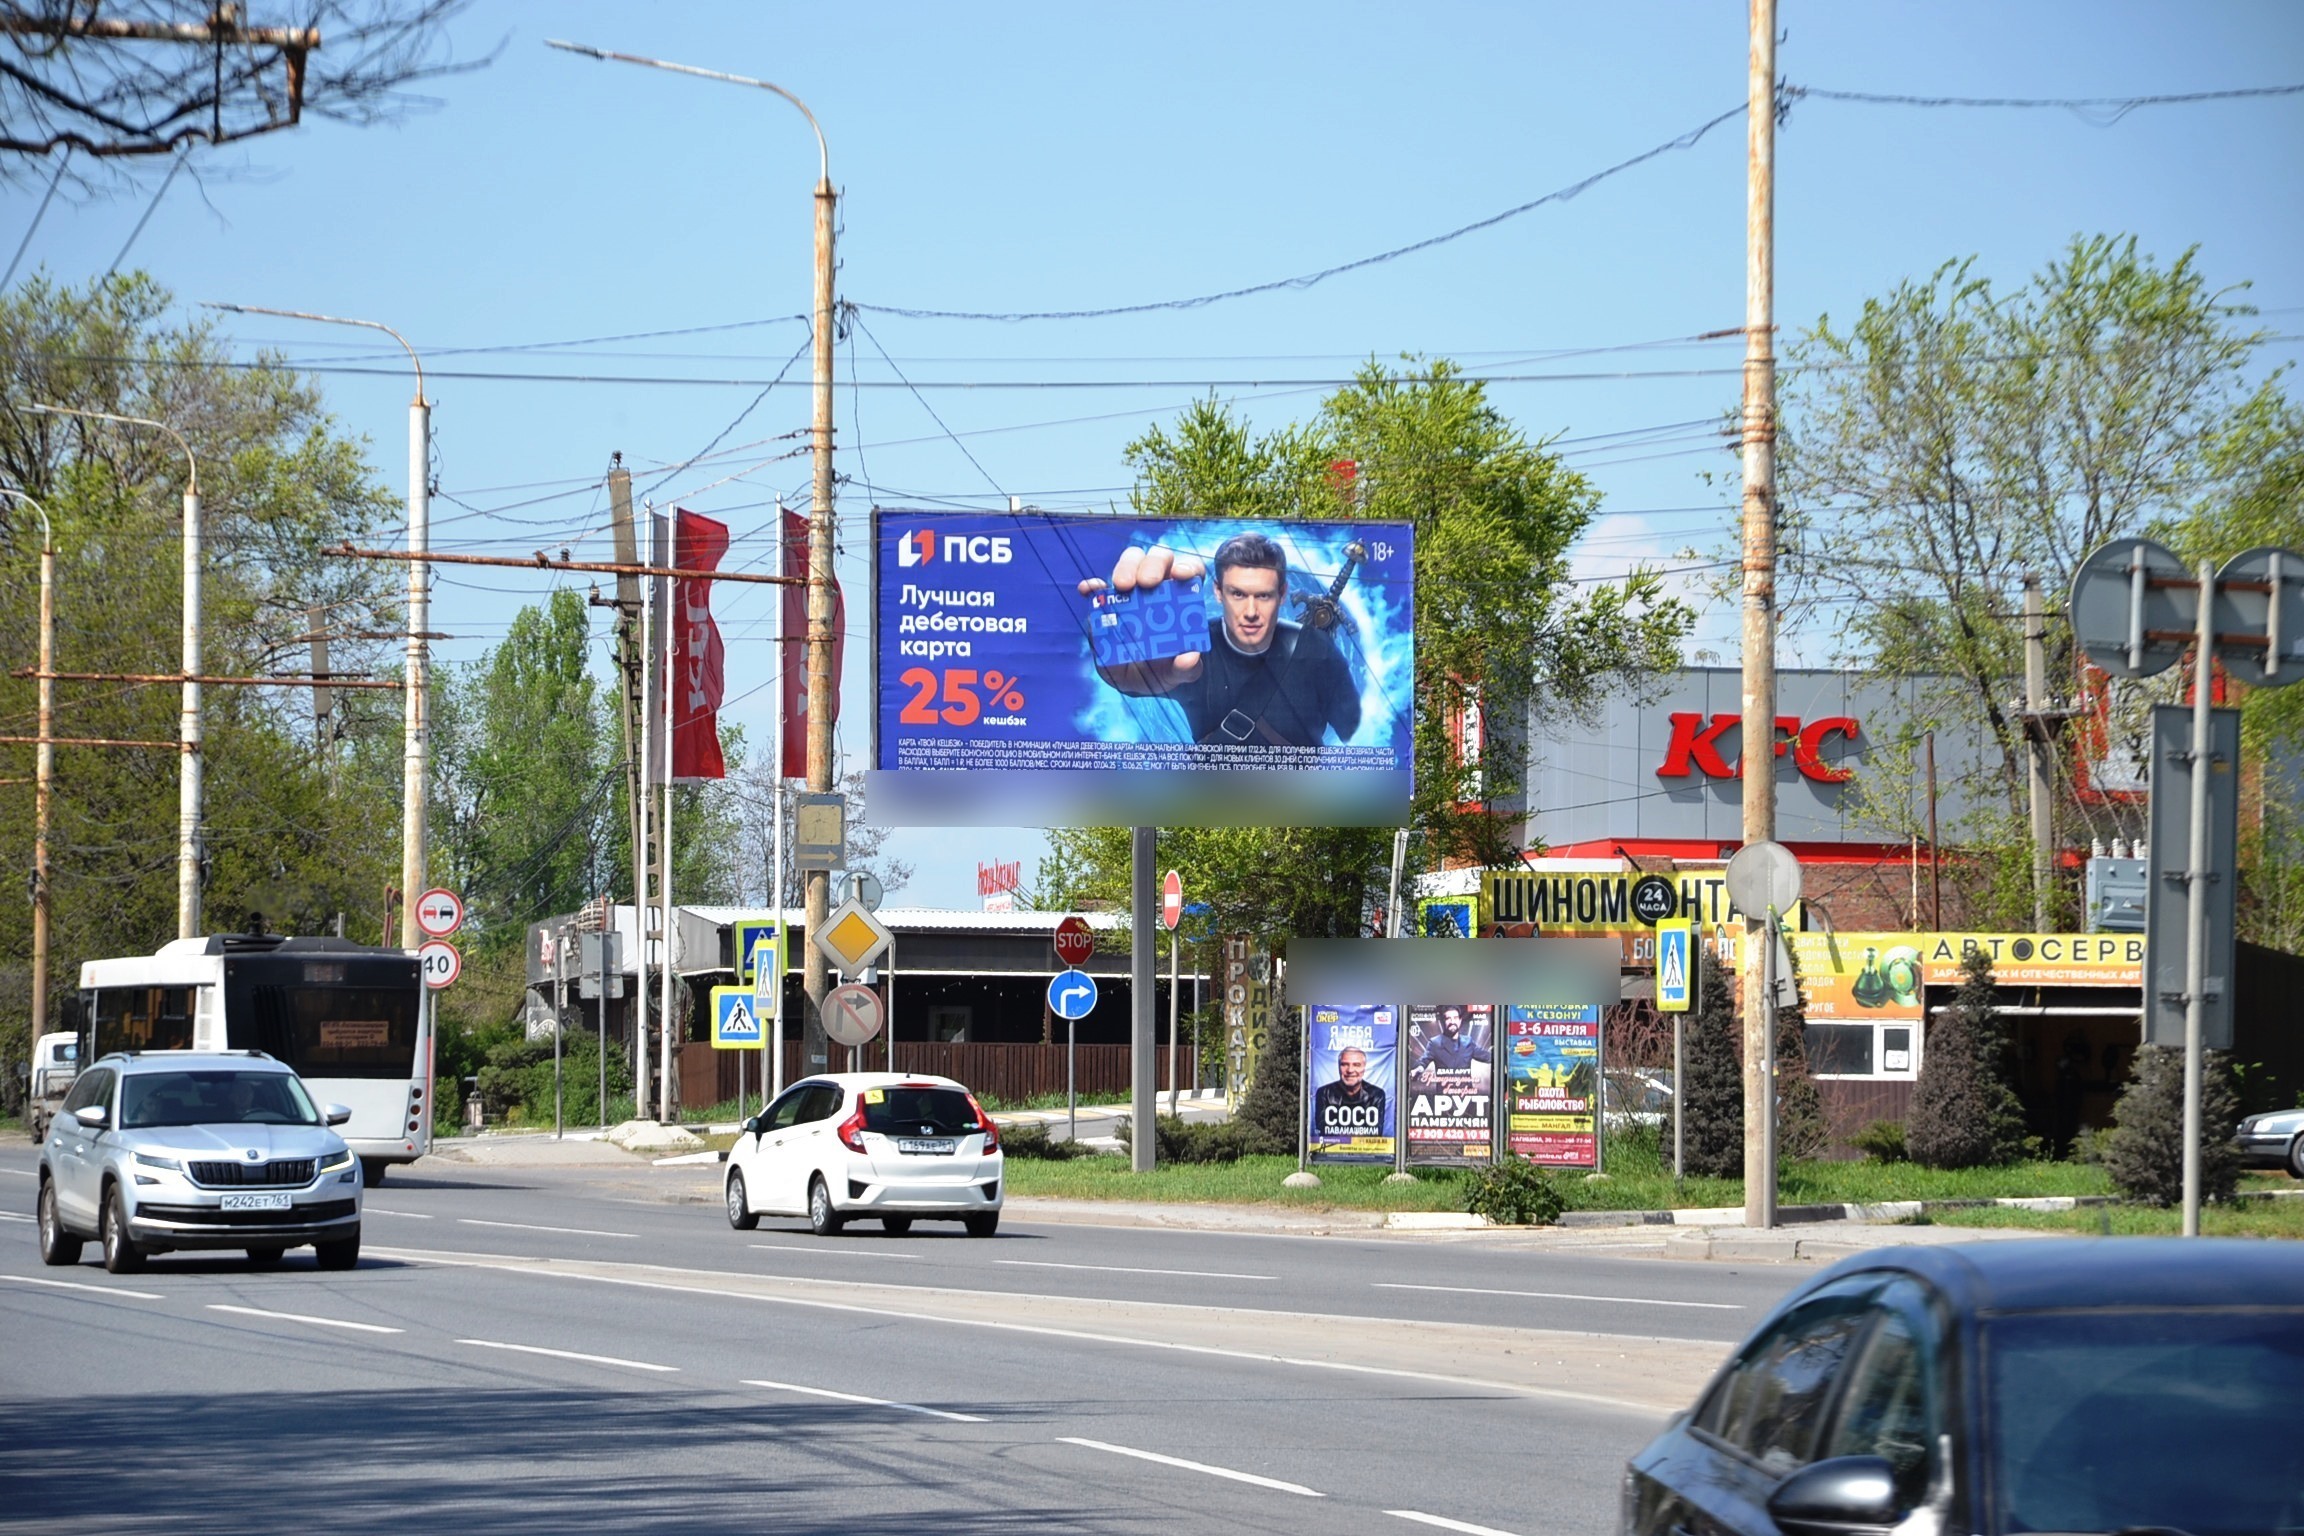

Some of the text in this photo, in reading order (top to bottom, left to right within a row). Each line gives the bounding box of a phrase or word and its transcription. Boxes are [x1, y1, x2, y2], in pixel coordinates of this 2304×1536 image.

[944, 536, 1013, 564] ПСБ
[1372, 542, 1394, 562] 18+
[899, 584, 995, 610] Лучшая
[899, 611, 1027, 634] дебетовая
[900, 640, 971, 661] карта
[899, 667, 1025, 727] 25%
[983, 715, 1027, 726] кешбэк
[898, 739, 917, 748] КАРТА
[969, 740, 1007, 749] ПОБЕДИТЕЛЬ
[1014, 741, 1051, 750] НОМИНАЦИИ
[1080, 742, 1113, 751] ДЕБЕТОВАЯ
[1135, 742, 1184, 752] НАЦИОНАЛЬНОЙ
[1224, 745, 1248, 754] ПРЕМИИ
[1268, 746, 1282, 755] ДЛЯ
[1282, 746, 1316, 755] ПОЛУЧЕНИЯ
[1655, 712, 1860, 783] KFC
[932, 748, 961, 758] ВЫБЕРИТЕ
[961, 749, 994, 758] БОНУСНУЮ
[995, 750, 1018, 759] ОПЦИЮ
[1023, 750, 1061, 759] МОБИЛЬНОМ
[1061, 751, 1074, 760] ИЛИ
[1159, 753, 1167, 761] НА
[1180, 753, 1207, 762] ПОКУПКИ
[1210, 754, 1223, 763] ДЛЯ
[1224, 754, 1244, 763] НОВЫХ
[1244, 755, 1274, 763] КЛИЕНТОВ
[1282, 754, 1298, 764] ДНЕЙ
[1303, 755, 1338, 765] ПОЛУЧЕНИЯ
[1358, 757, 1395, 766] НАЧИСЛЕНИЕ
[933, 758, 951, 767] БАЛЛ
[975, 758, 994, 767] БОЛЕЕ
[1050, 760, 1071, 769] СРОКИ
[1644, 888, 1663, 901] 24
[1639, 904, 1667, 912] ЧАСА
[1057, 933, 1092, 949] STOP
[424, 955, 450, 974] 40
[2010, 969, 2020, 978] И
[2020, 969, 2117, 980] ОТЕЧЕСТВЕННЫХ
[1527, 1011, 1581, 1020] К СЕЗОНУ!
[1330, 1025, 1373, 1039] Я ТЕБЯ
[1518, 1022, 1587, 1036] 3-6 АПРЕЛЯ
[1554, 1039, 1593, 1047] ВЫСТАВКА
[1538, 1087, 1565, 1099] ОХОТА
[1410, 1094, 1491, 1117] АРУТ
[1518, 1098, 1585, 1112] РЫБОЛОВСТВО
[1325, 1105, 1379, 1127] СОСО
[1411, 1117, 1489, 1128] ПАМБУКЧЯН
[1324, 1126, 1379, 1136] ПАВЛИАШВИЛИ
[1541, 1122, 1571, 1130] МАНГАЛ
[1409, 1129, 1490, 1139] +7 909 420 10 10
